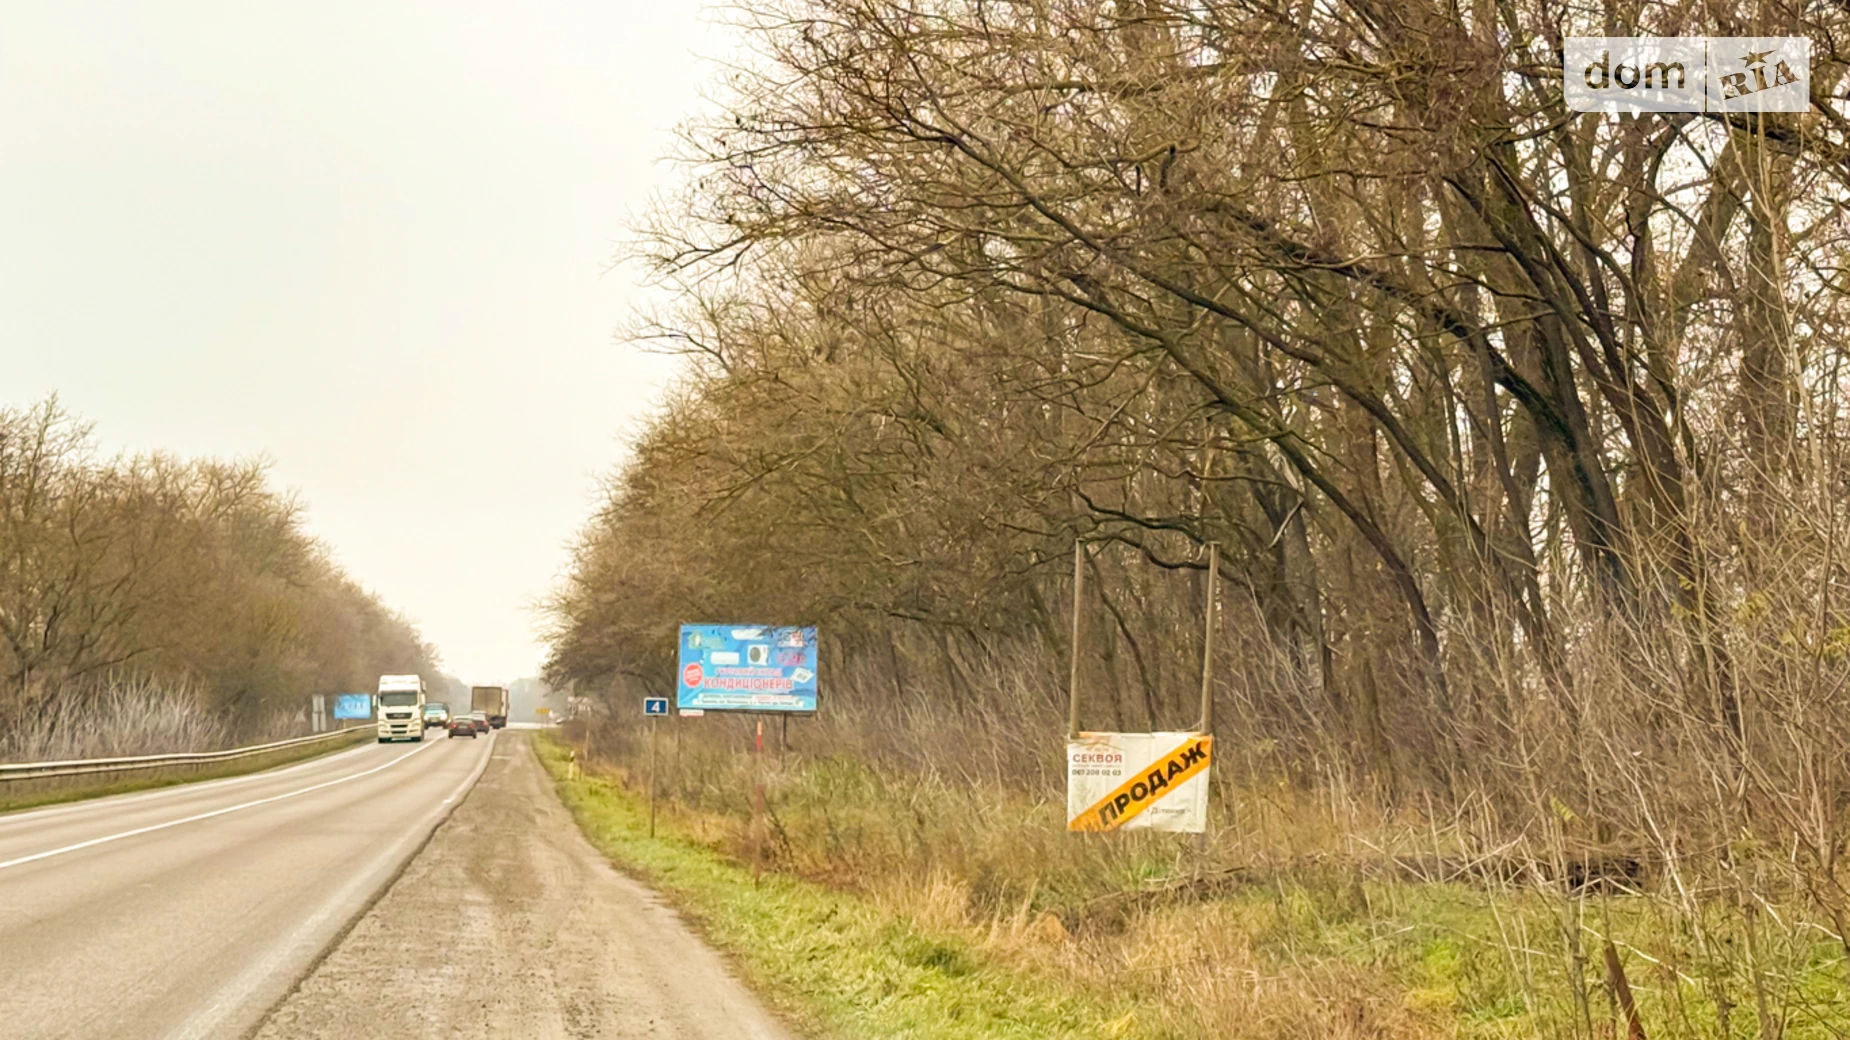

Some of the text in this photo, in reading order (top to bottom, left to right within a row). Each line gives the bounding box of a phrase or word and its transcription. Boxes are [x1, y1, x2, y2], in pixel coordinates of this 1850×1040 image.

[703, 677, 794, 690] КОНДИЦІОНЕРІВ
[651, 701, 660, 713] 4
[1072, 753, 1123, 764] СЕКВОЯ
[1098, 740, 1207, 826] ПРОДАЖ
